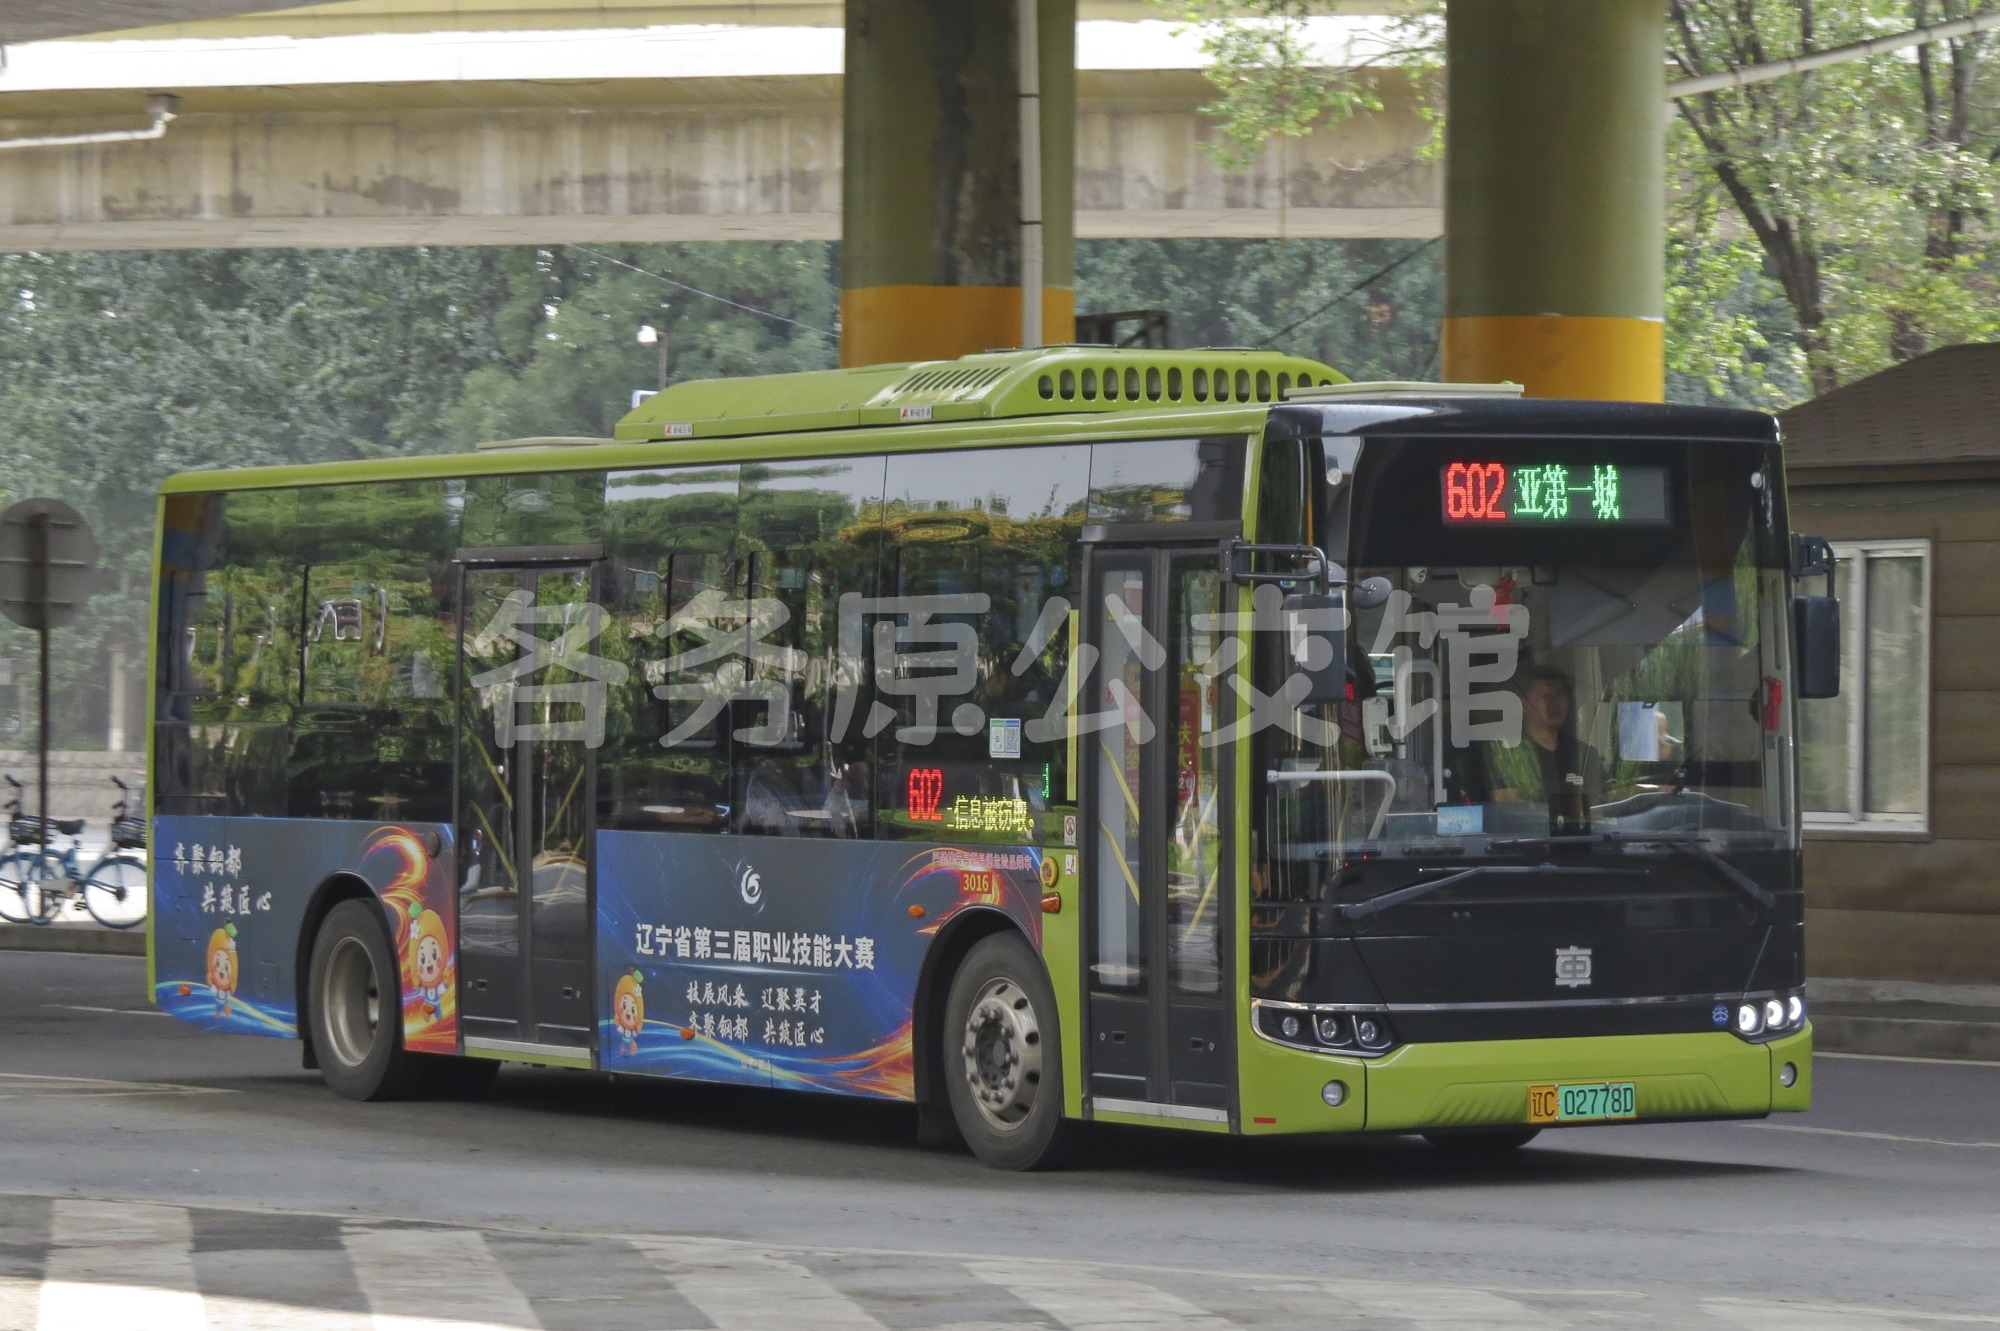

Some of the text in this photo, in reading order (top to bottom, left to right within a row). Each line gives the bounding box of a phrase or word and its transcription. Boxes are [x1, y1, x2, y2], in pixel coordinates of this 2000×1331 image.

[1447, 462, 1619, 519] 602 亚第一城
[908, 768, 943, 821] 602
[963, 874, 989, 892] 3016
[635, 923, 875, 970] 辽宁省第三届职业技能大赛
[686, 980, 749, 1008] 技展风采
[688, 1010, 825, 1047] 齐聚钢都 共筑匠心
